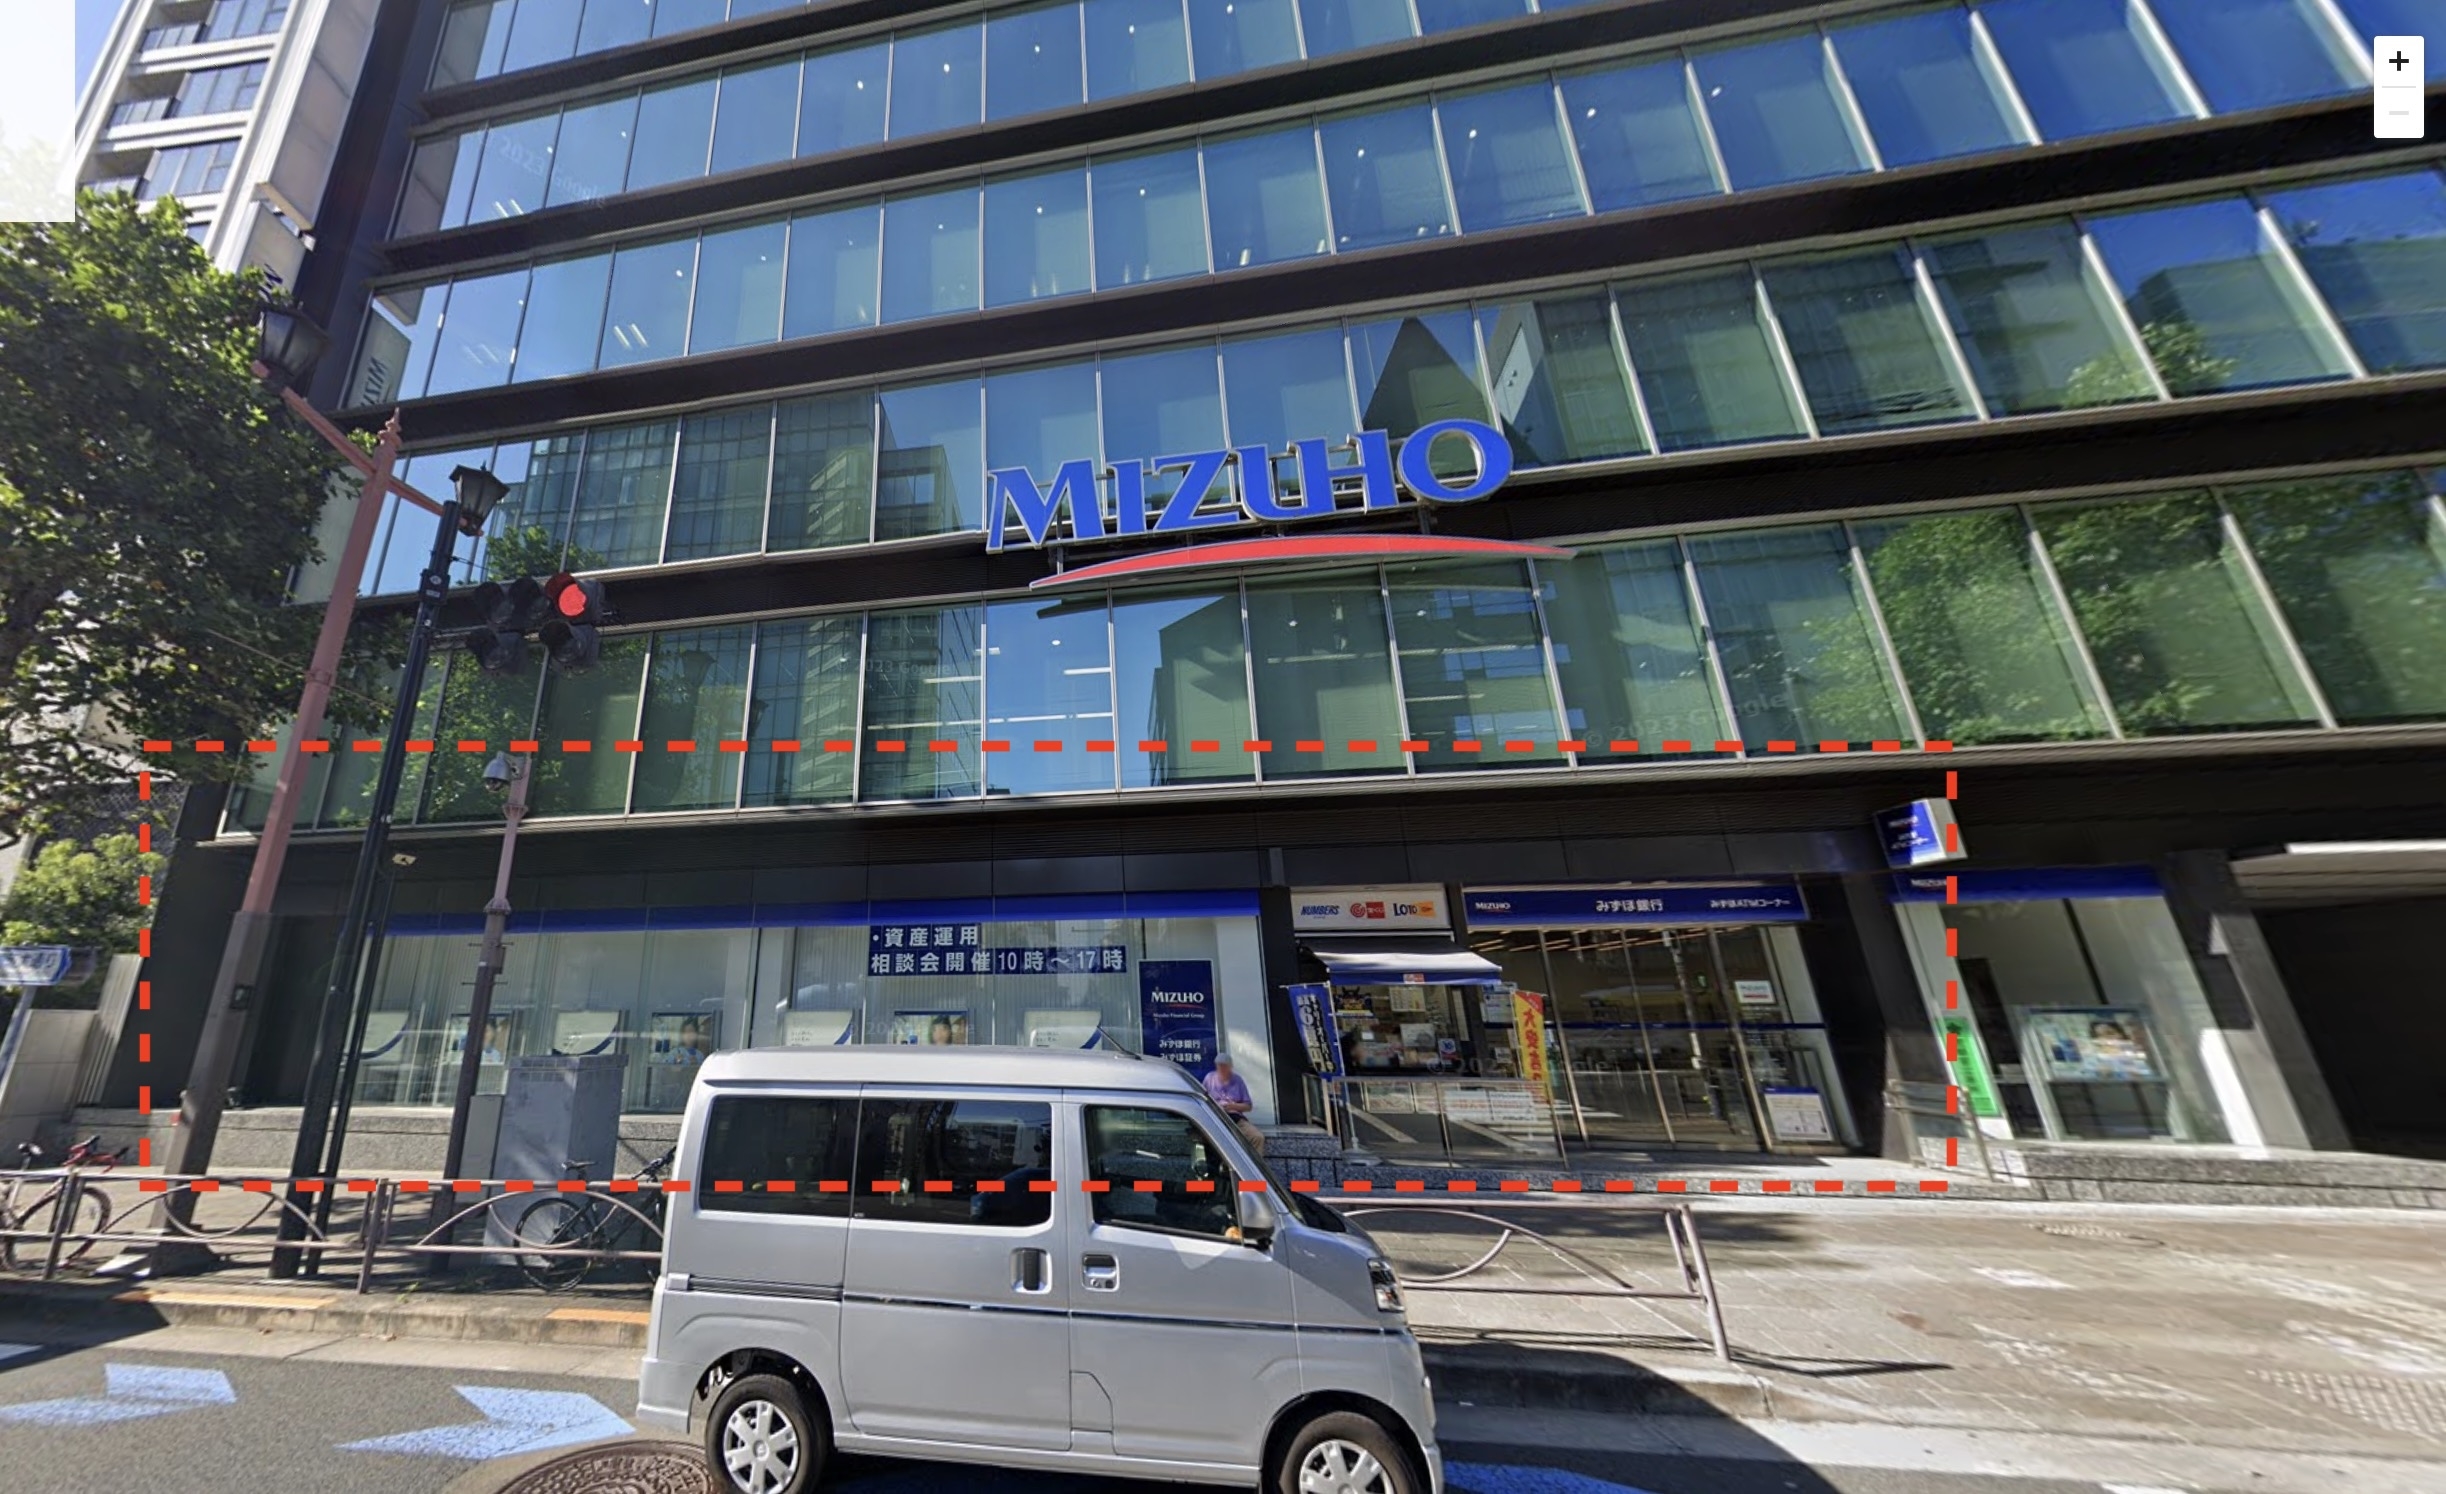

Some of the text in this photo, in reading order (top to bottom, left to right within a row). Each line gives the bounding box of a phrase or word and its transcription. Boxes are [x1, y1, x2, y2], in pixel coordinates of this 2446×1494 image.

[986, 419, 1514, 553] MIZUHO
[1300, 904, 1340, 916] NUMBERS
[1393, 903, 1418, 917] LOTO
[1474, 901, 1512, 911] MIZUHO
[1595, 898, 1663, 913] みずほ銀行
[1151, 991, 1205, 1003] MIZUHO
[1159, 1038, 1201, 1049] みずほ銀行
